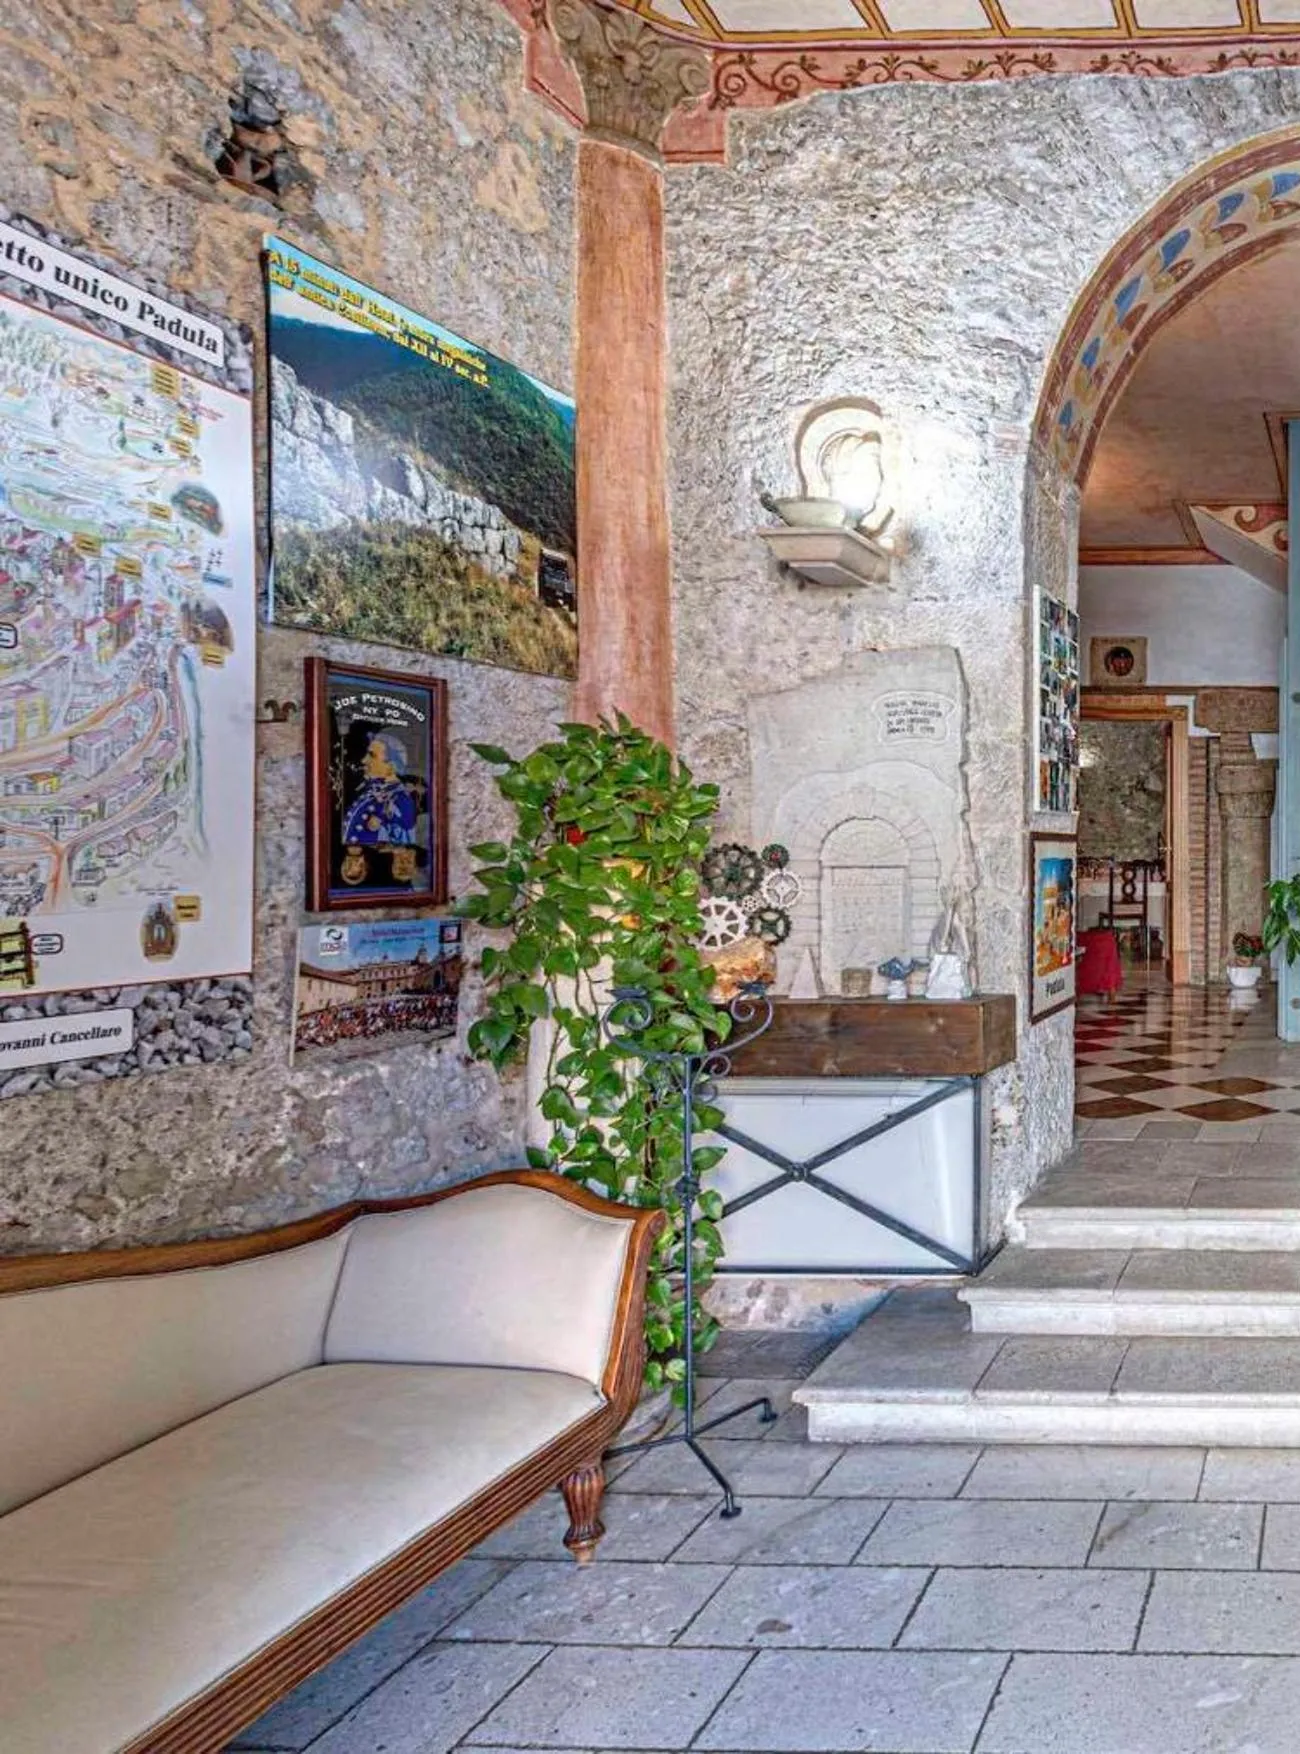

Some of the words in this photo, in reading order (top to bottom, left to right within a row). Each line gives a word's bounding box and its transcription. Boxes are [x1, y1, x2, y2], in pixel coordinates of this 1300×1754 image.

[0, 239, 44, 272] tto
[54, 265, 128, 312] unico
[137, 298, 218, 353] Padula
[334, 696, 357, 711] JOE
[362, 693, 425, 722] PETROSINO
[50, 1025, 122, 1045] Cancellaro
